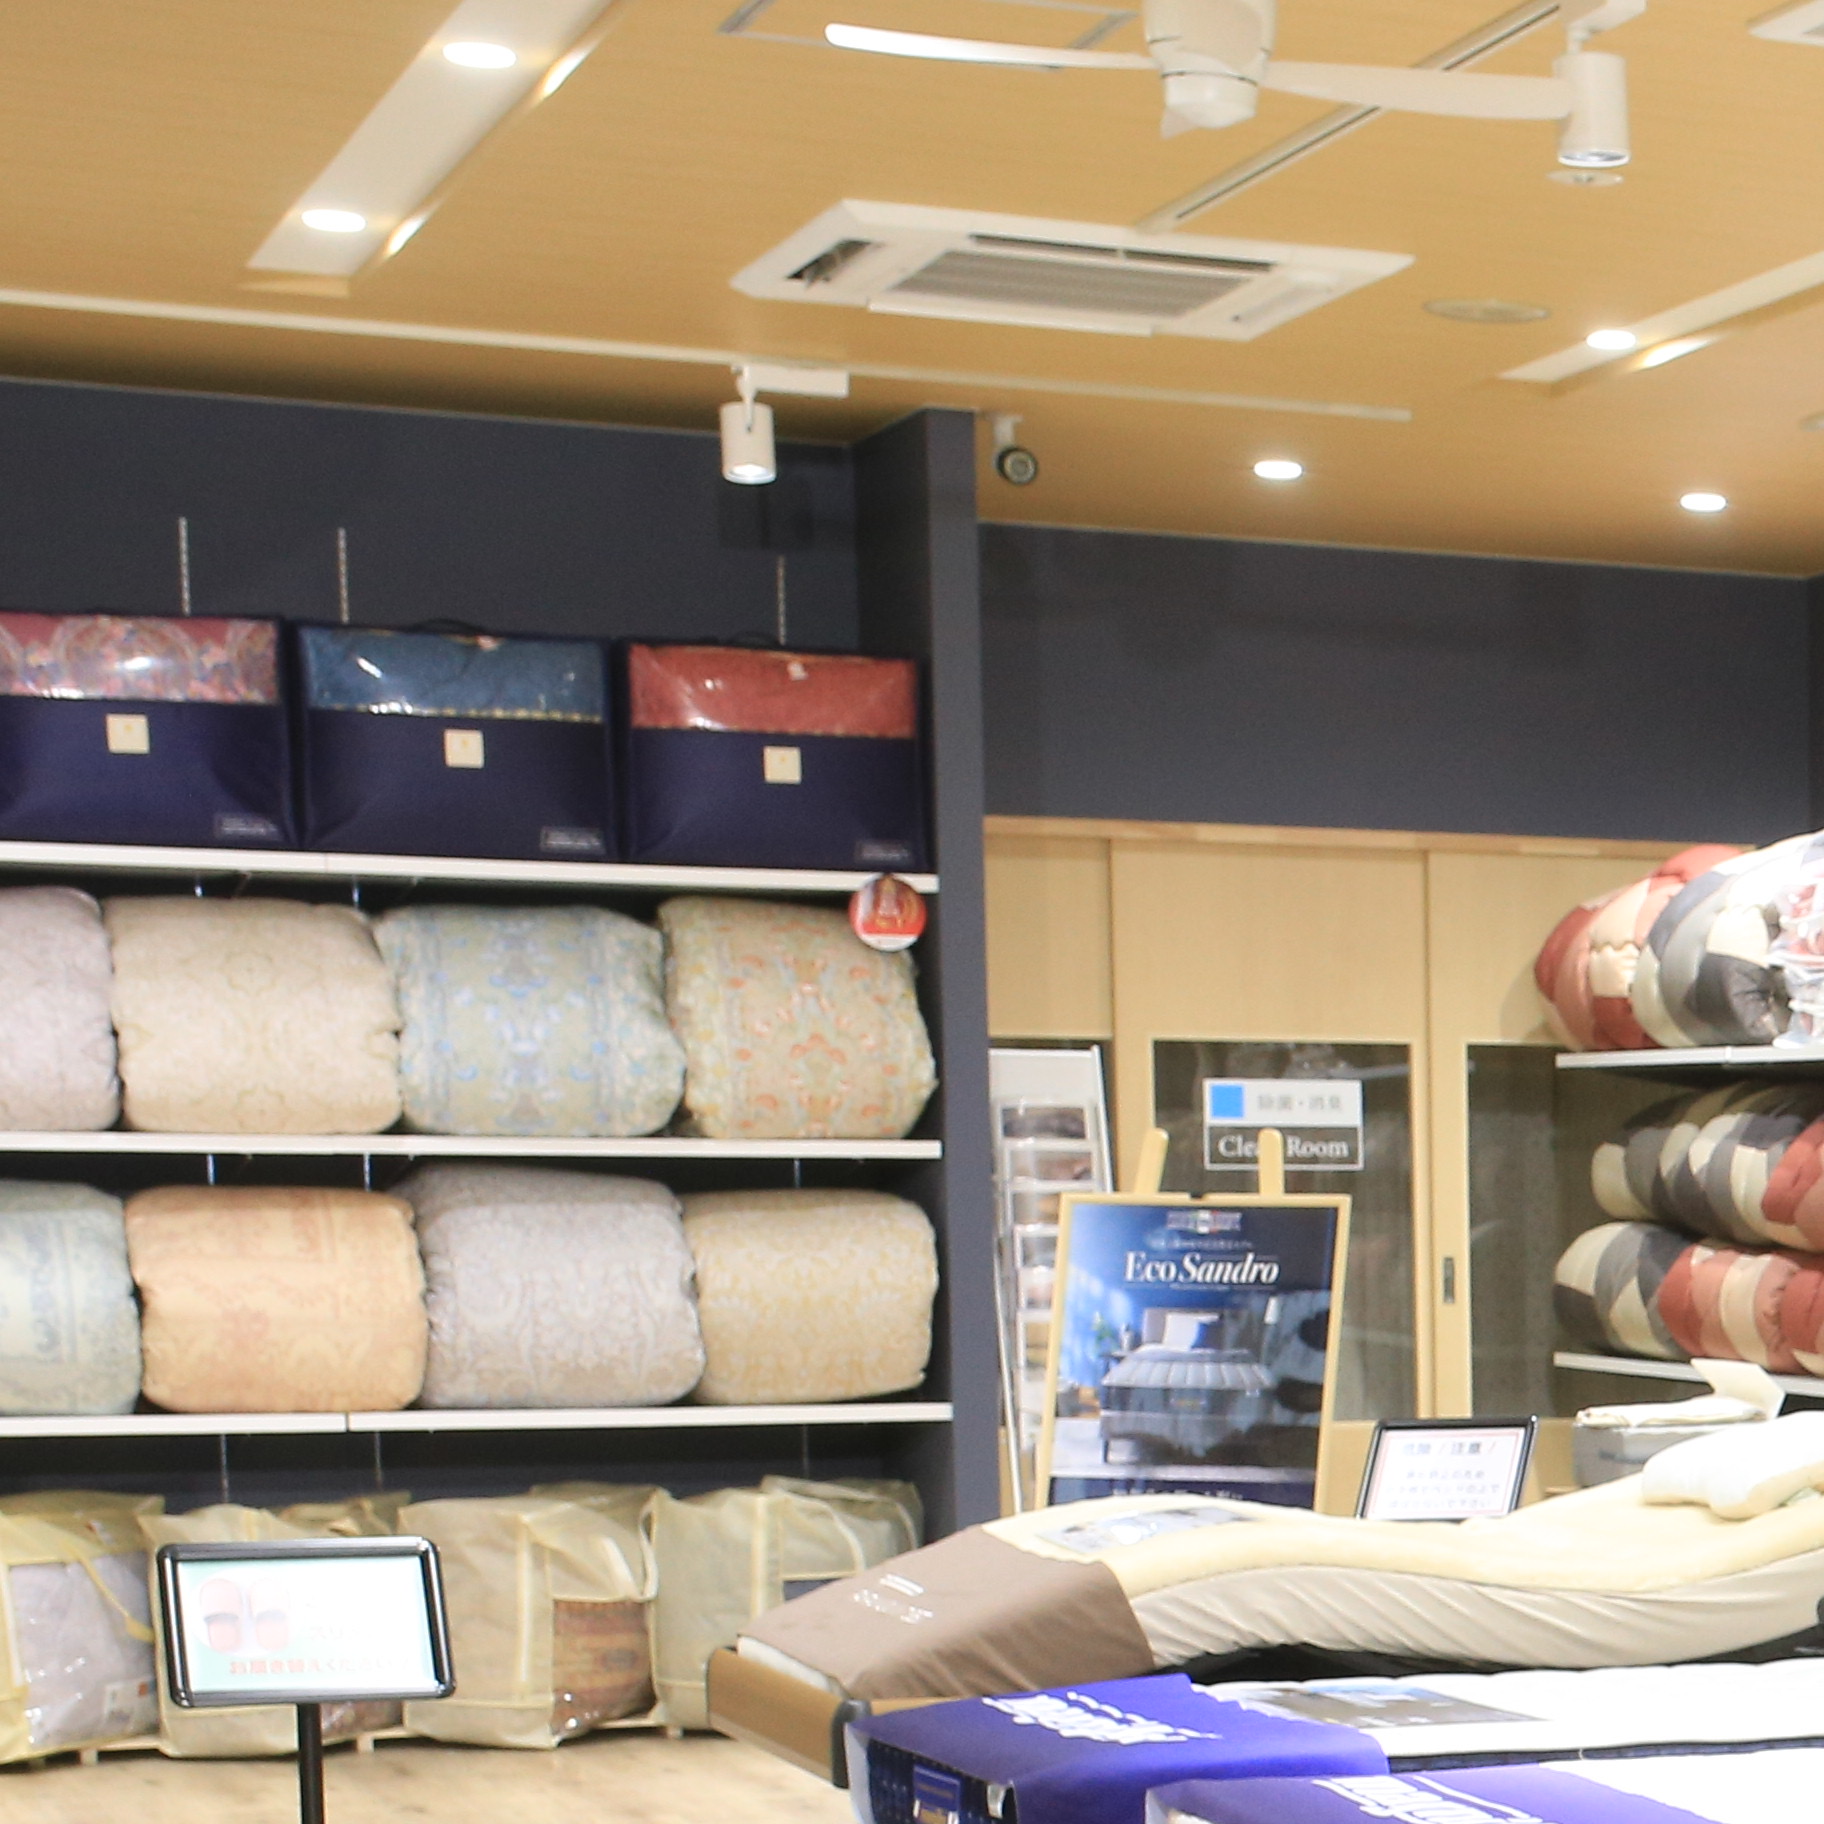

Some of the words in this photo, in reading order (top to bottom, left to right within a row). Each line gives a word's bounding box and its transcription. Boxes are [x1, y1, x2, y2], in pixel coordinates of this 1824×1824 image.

[1286, 1134, 1350, 1159] Room
[1124, 1250, 1177, 1283] Eco
[1178, 1251, 1280, 1285] Sandro
